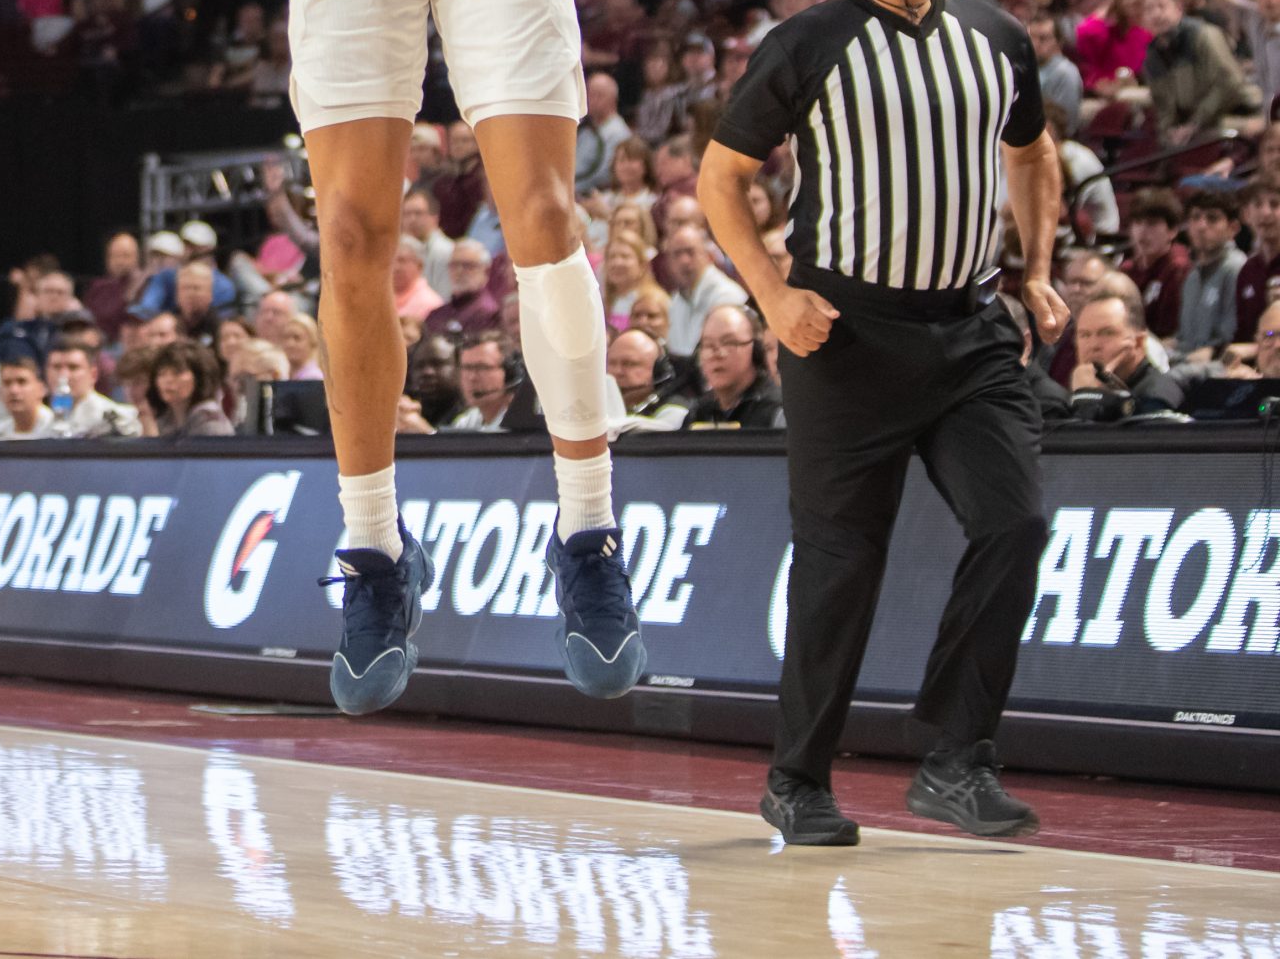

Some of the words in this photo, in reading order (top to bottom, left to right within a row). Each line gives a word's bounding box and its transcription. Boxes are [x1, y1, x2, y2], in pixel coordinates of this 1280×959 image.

[204, 470, 302, 629] G
[325, 498, 721, 624] TORDE
[1174, 711, 1236, 726] DAKTRONICS
